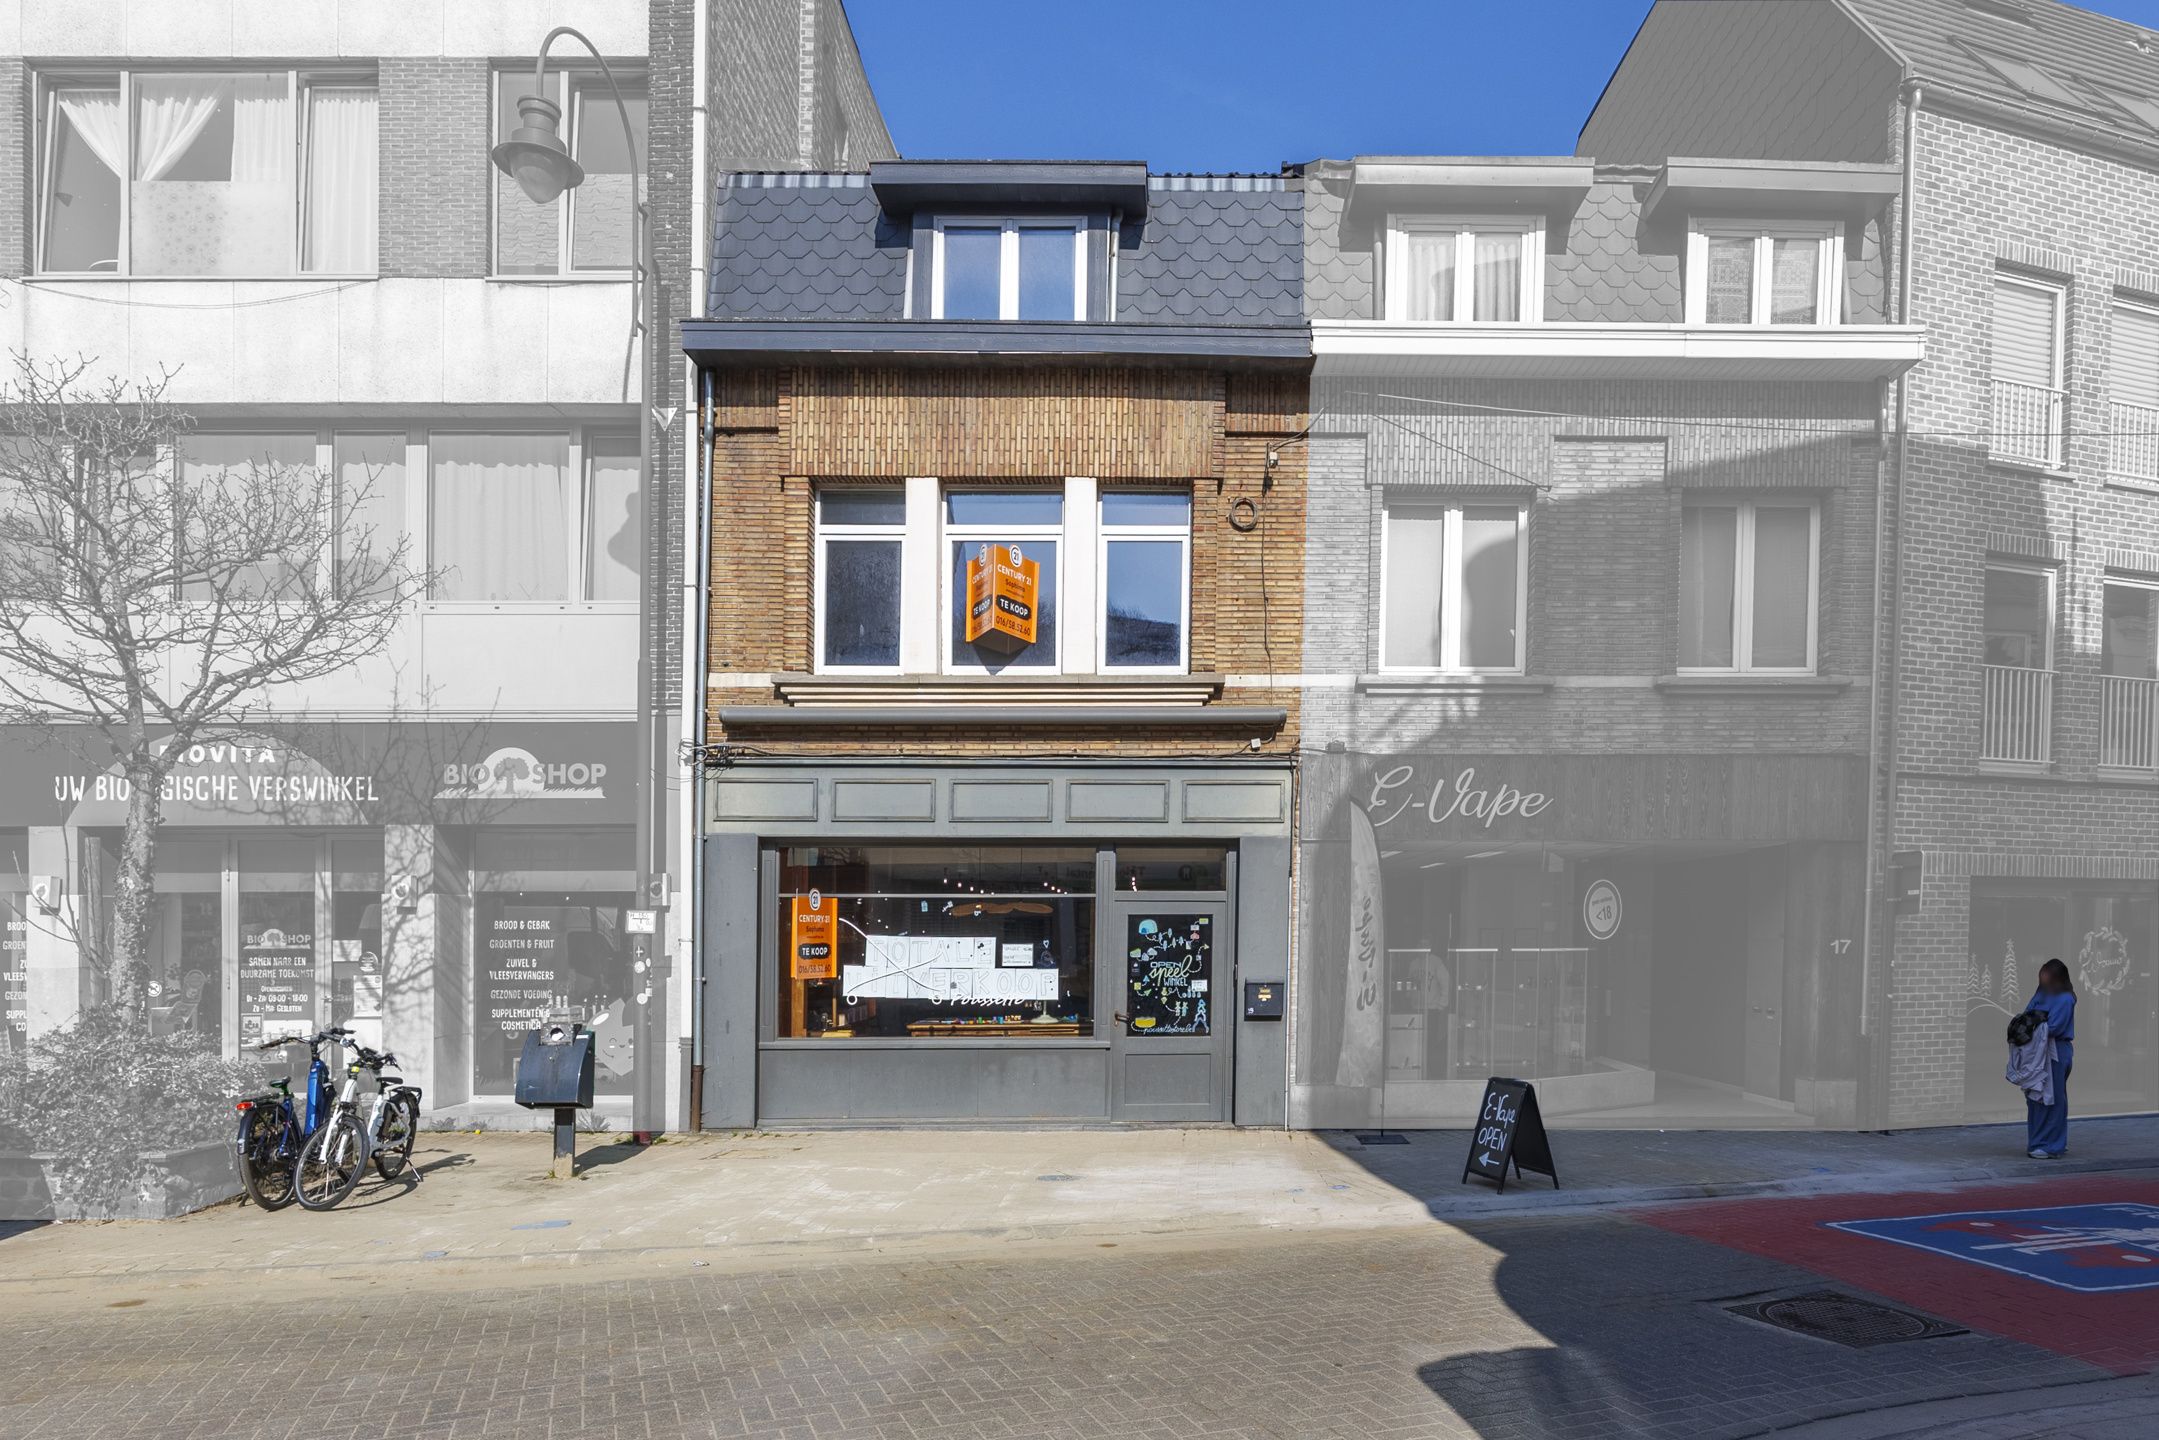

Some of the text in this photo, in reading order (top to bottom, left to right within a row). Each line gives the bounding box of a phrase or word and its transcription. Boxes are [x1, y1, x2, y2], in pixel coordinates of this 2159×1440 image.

[997, 563, 1032, 586] CENTURY 21
[979, 599, 990, 611] KOOP
[1000, 598, 1029, 617] TE KOOP
[996, 615, 1031, 636] 016/58.52.60
[159, 744, 276, 763] OVITA
[443, 763, 607, 785] BIO SHOP
[55, 775, 379, 801] UW BIOGISCHE VERSWINKEL
[1367, 765, 1554, 828] E-Vape
[799, 914, 824, 923] CENTURY
[7, 922, 26, 931] BROO
[494, 920, 551, 930] BROOD & GEBAK
[247, 934, 311, 944] BIO SHOP
[489, 939, 554, 949] GROENTEN & FRUIT
[802, 947, 828, 956] TE KOOP
[1830, 939, 1851, 954] 17
[873, 939, 992, 965] TOTALE
[249, 957, 307, 966] SAMEN NAAR EEN
[506, 958, 537, 968] ZUIVEL &
[240, 969, 314, 978] DUURZAME TOEKOMST
[489, 970, 554, 980] VLEESVERVANGERS
[1149, 955, 1193, 987] speel
[1163, 977, 1188, 987] WINKEL
[490, 990, 553, 999] GEZONDE VOEDING
[491, 1008, 546, 1018] SUPPLEMENTEN
[501, 1021, 542, 1030] COSMETICA
[1483, 1092, 1516, 1129] E-Vape
[1477, 1126, 1508, 1152] OPEN
